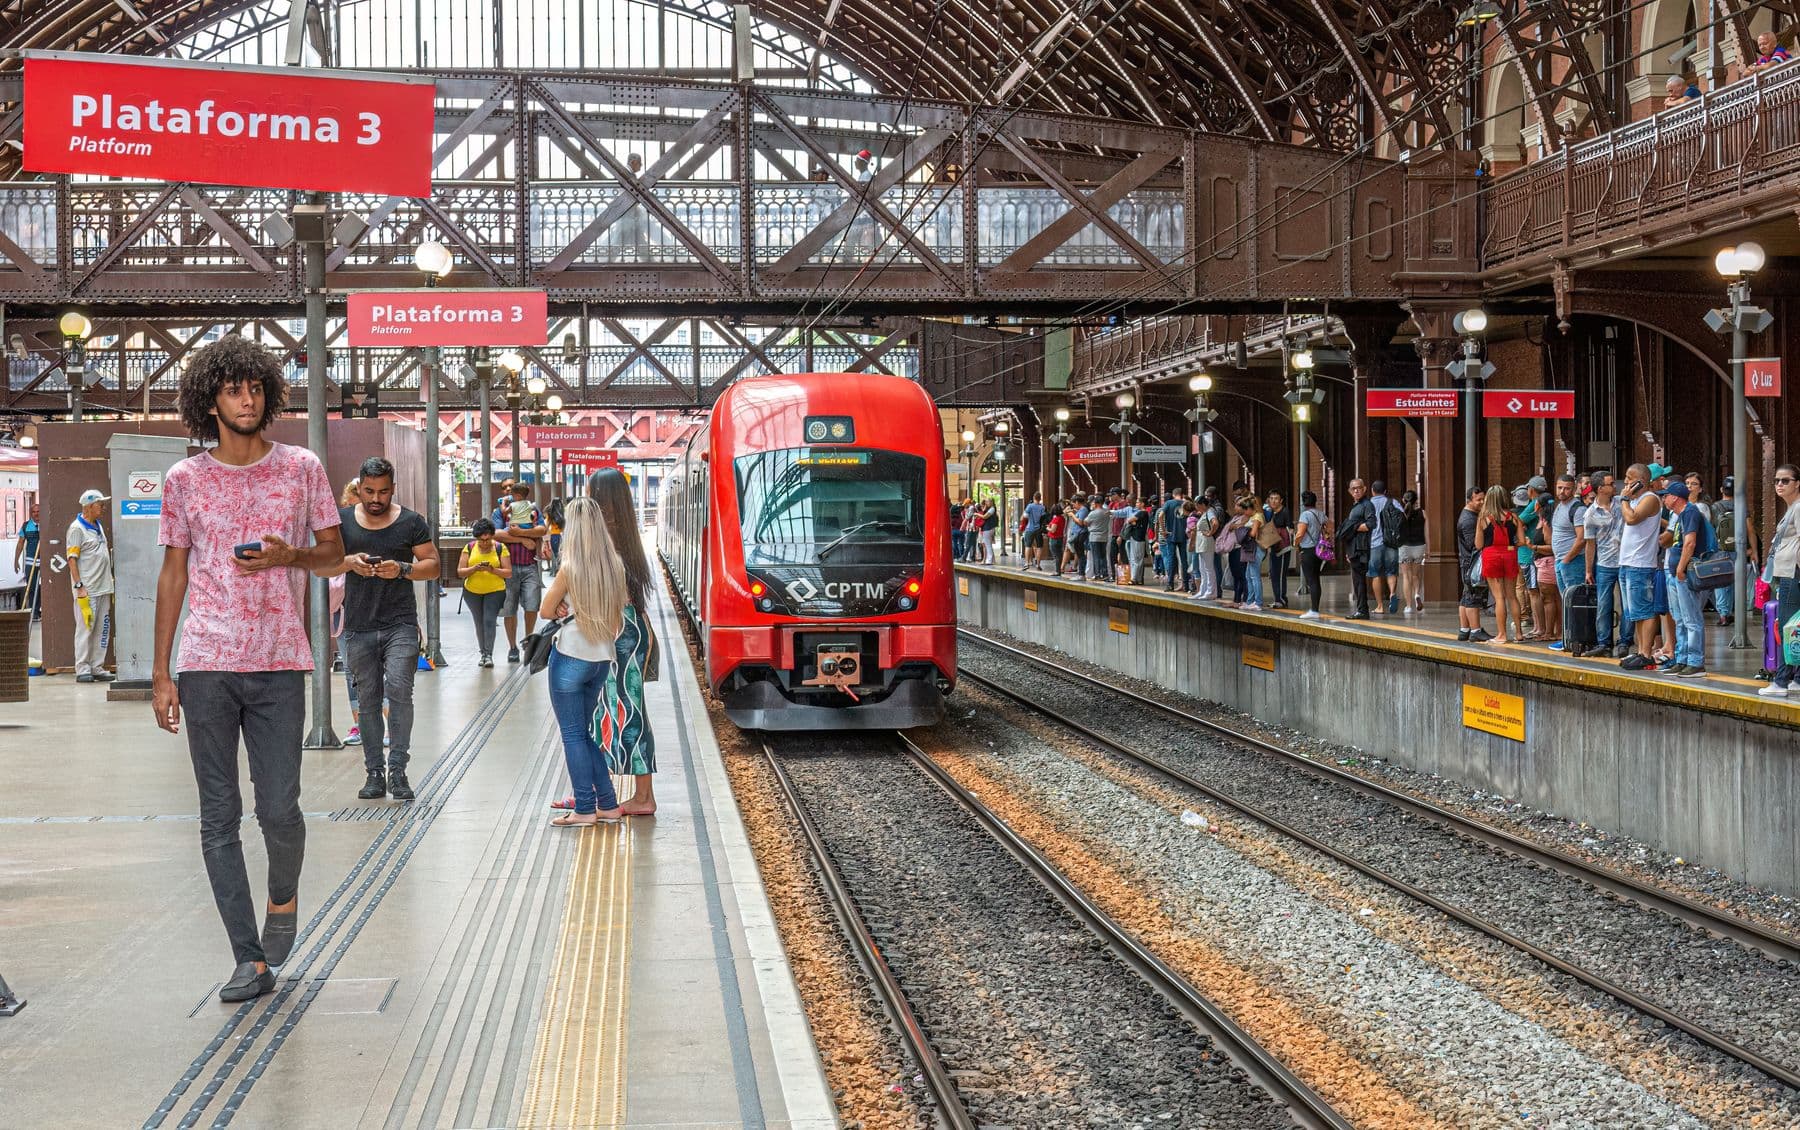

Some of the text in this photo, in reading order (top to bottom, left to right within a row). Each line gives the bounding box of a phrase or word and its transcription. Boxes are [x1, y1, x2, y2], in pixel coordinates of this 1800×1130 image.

[72, 94, 382, 145] Plataforma 3
[69, 135, 152, 156] Platform
[371, 305, 523, 323] Plataforma 3
[371, 325, 412, 335] Platform
[1760, 371, 1773, 387] Luz
[354, 384, 366, 393] Luz
[1395, 398, 1455, 407] Estudantes
[1530, 399, 1558, 411] Luz
[352, 408, 362, 416] Km
[824, 582, 884, 599] CPTM
